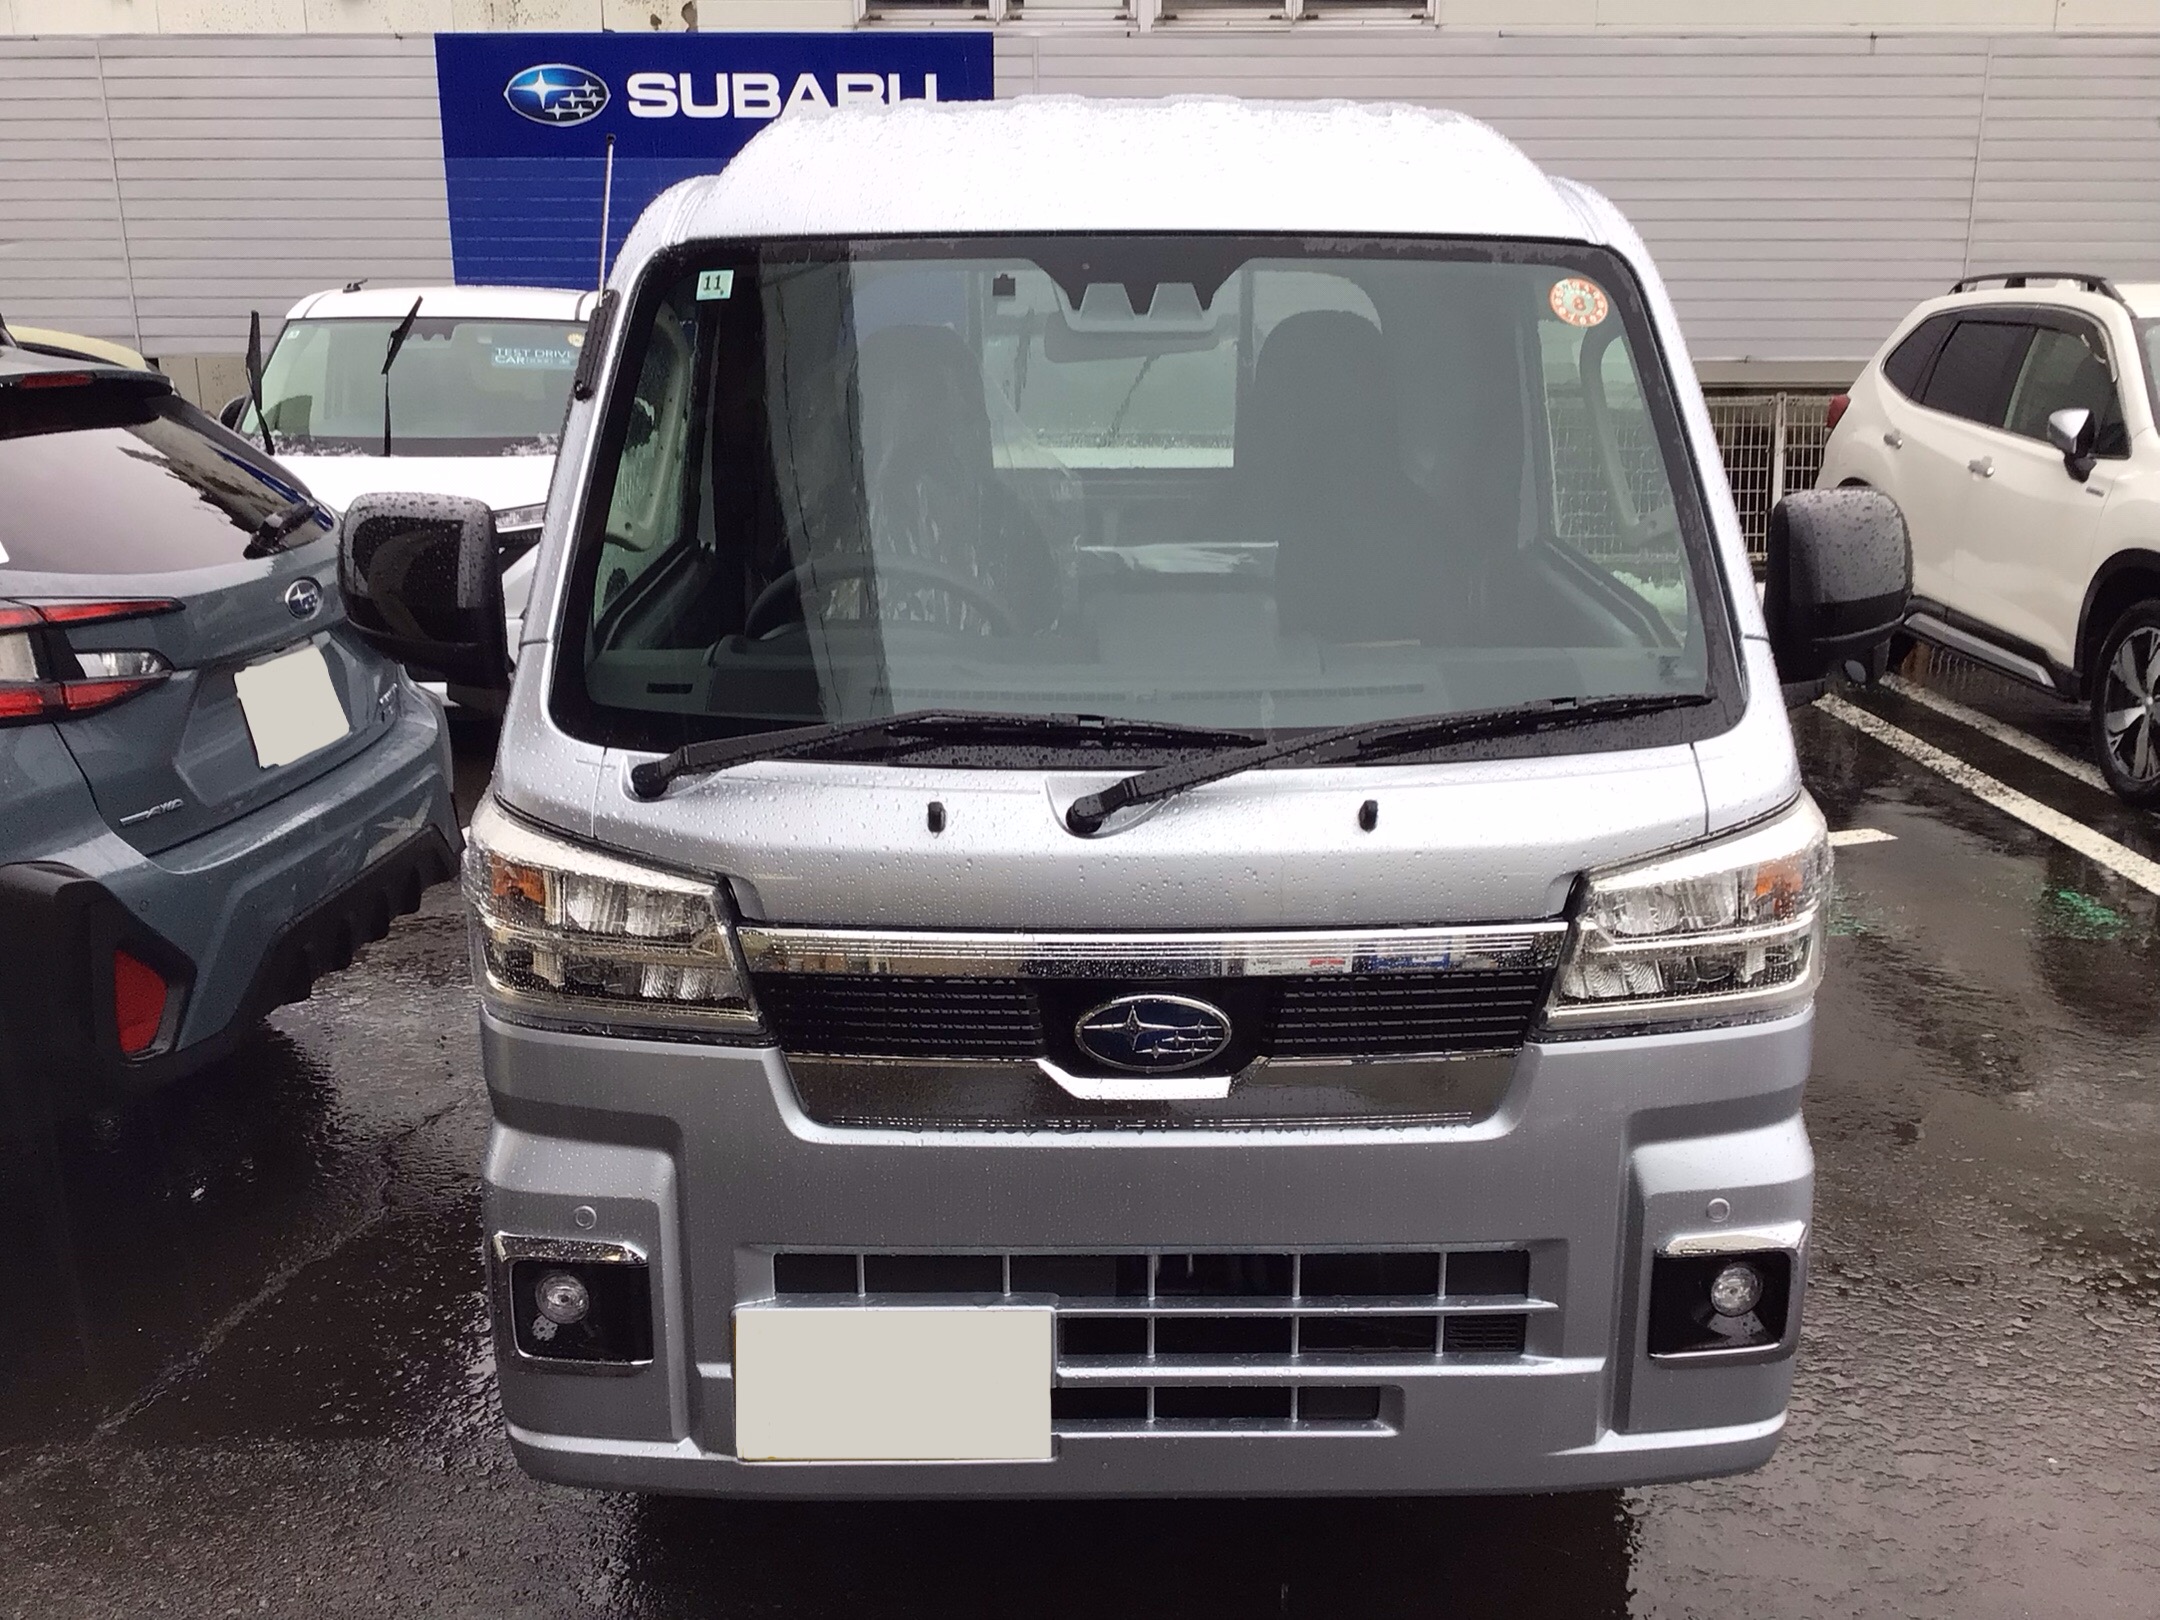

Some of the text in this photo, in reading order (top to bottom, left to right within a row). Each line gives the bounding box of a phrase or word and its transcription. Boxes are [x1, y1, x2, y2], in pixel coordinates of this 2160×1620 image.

[627, 72, 938, 118] SUBARU
[703, 274, 721, 290] 11
[495, 347, 530, 358] TEST
[494, 355, 525, 365] CAR
